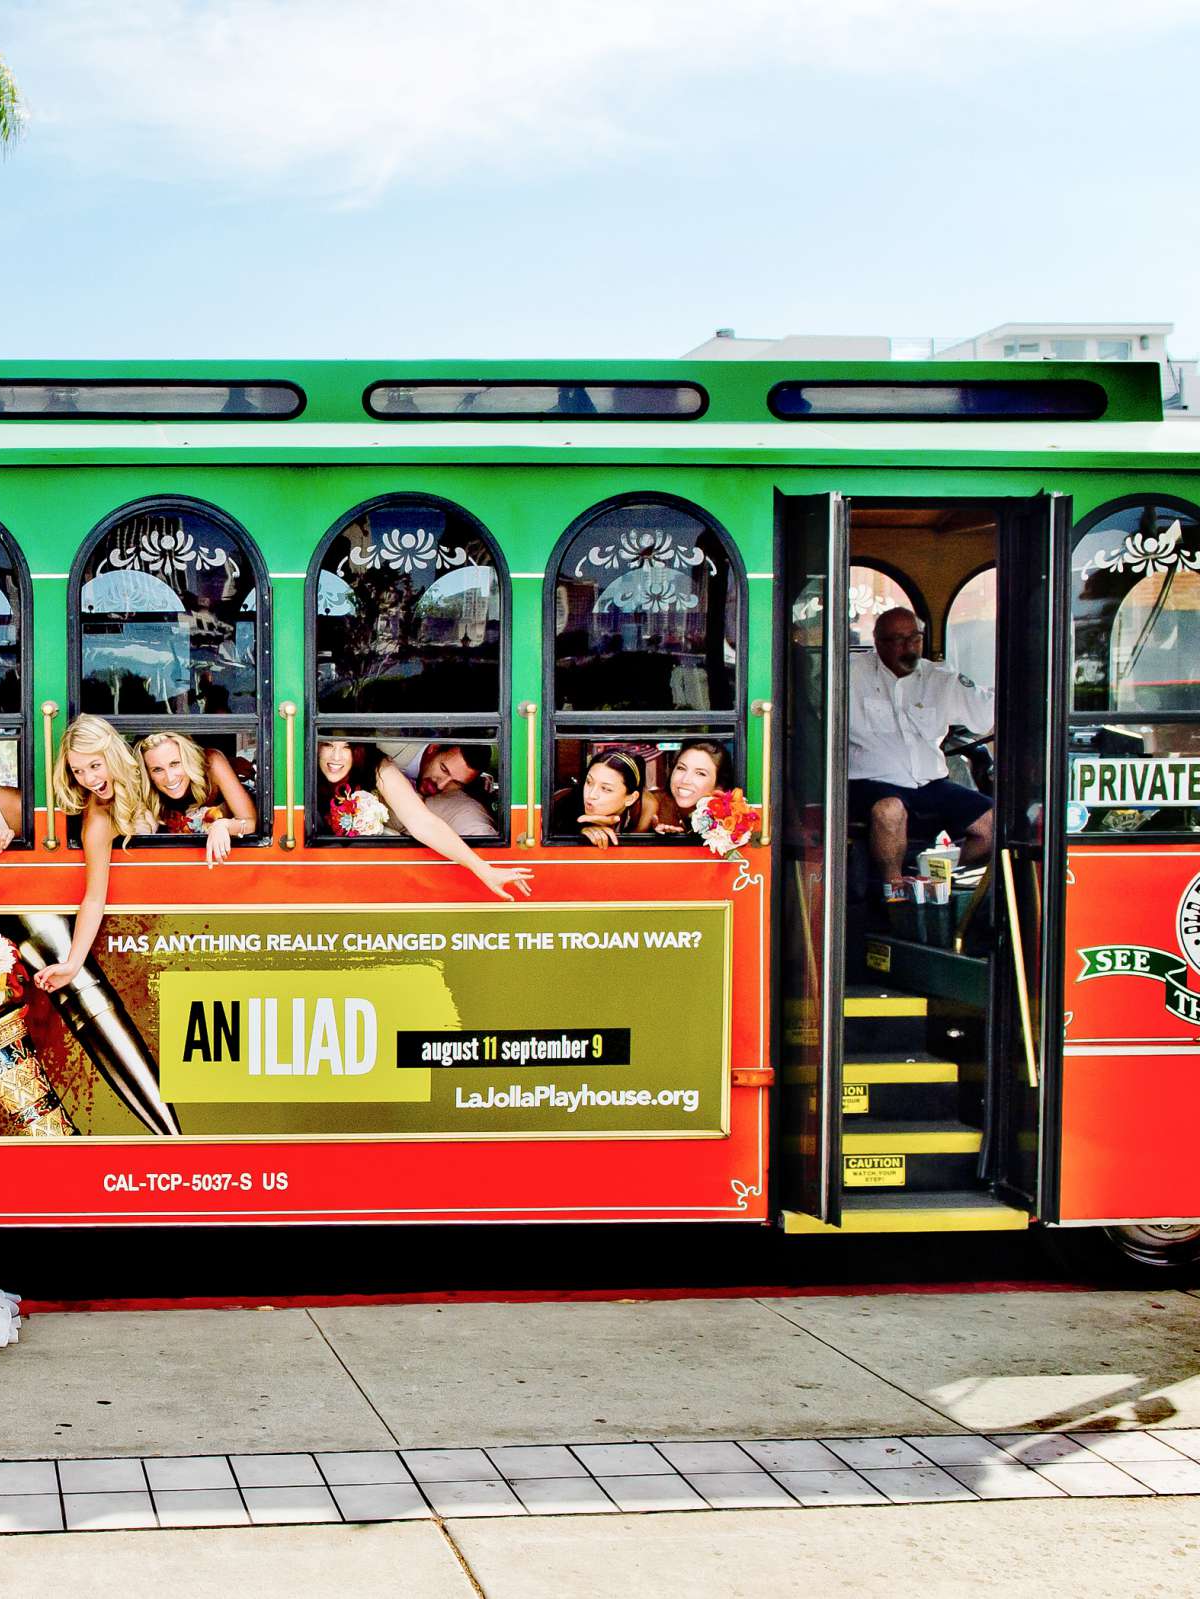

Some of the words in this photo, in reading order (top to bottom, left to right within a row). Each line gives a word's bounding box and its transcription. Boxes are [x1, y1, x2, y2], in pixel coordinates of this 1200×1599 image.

[1079, 763, 1200, 801] PRIVATE
[108, 935, 149, 952] HAS
[155, 934, 261, 952] ANYTHING
[267, 934, 338, 951] REALLY
[343, 933, 446, 951] CHANGED
[451, 933, 510, 951] SINCE
[515, 932, 554, 950] THE
[558, 931, 638, 950] TROJAN
[643, 931, 702, 949] WAR?
[1095, 950, 1150, 972] SEE
[183, 1001, 240, 1062] AN
[248, 997, 378, 1076] ILIAD
[421, 1037, 479, 1066] august
[482, 1036, 497, 1060] 11
[501, 1034, 588, 1064] september
[592, 1034, 602, 1058] 9
[455, 1083, 699, 1113] LaJollaPlayhouse.org
[848, 1158, 900, 1168] CAUTION
[103, 1173, 252, 1192] CAL-TCP-5037-S
[262, 1172, 289, 1190] US
